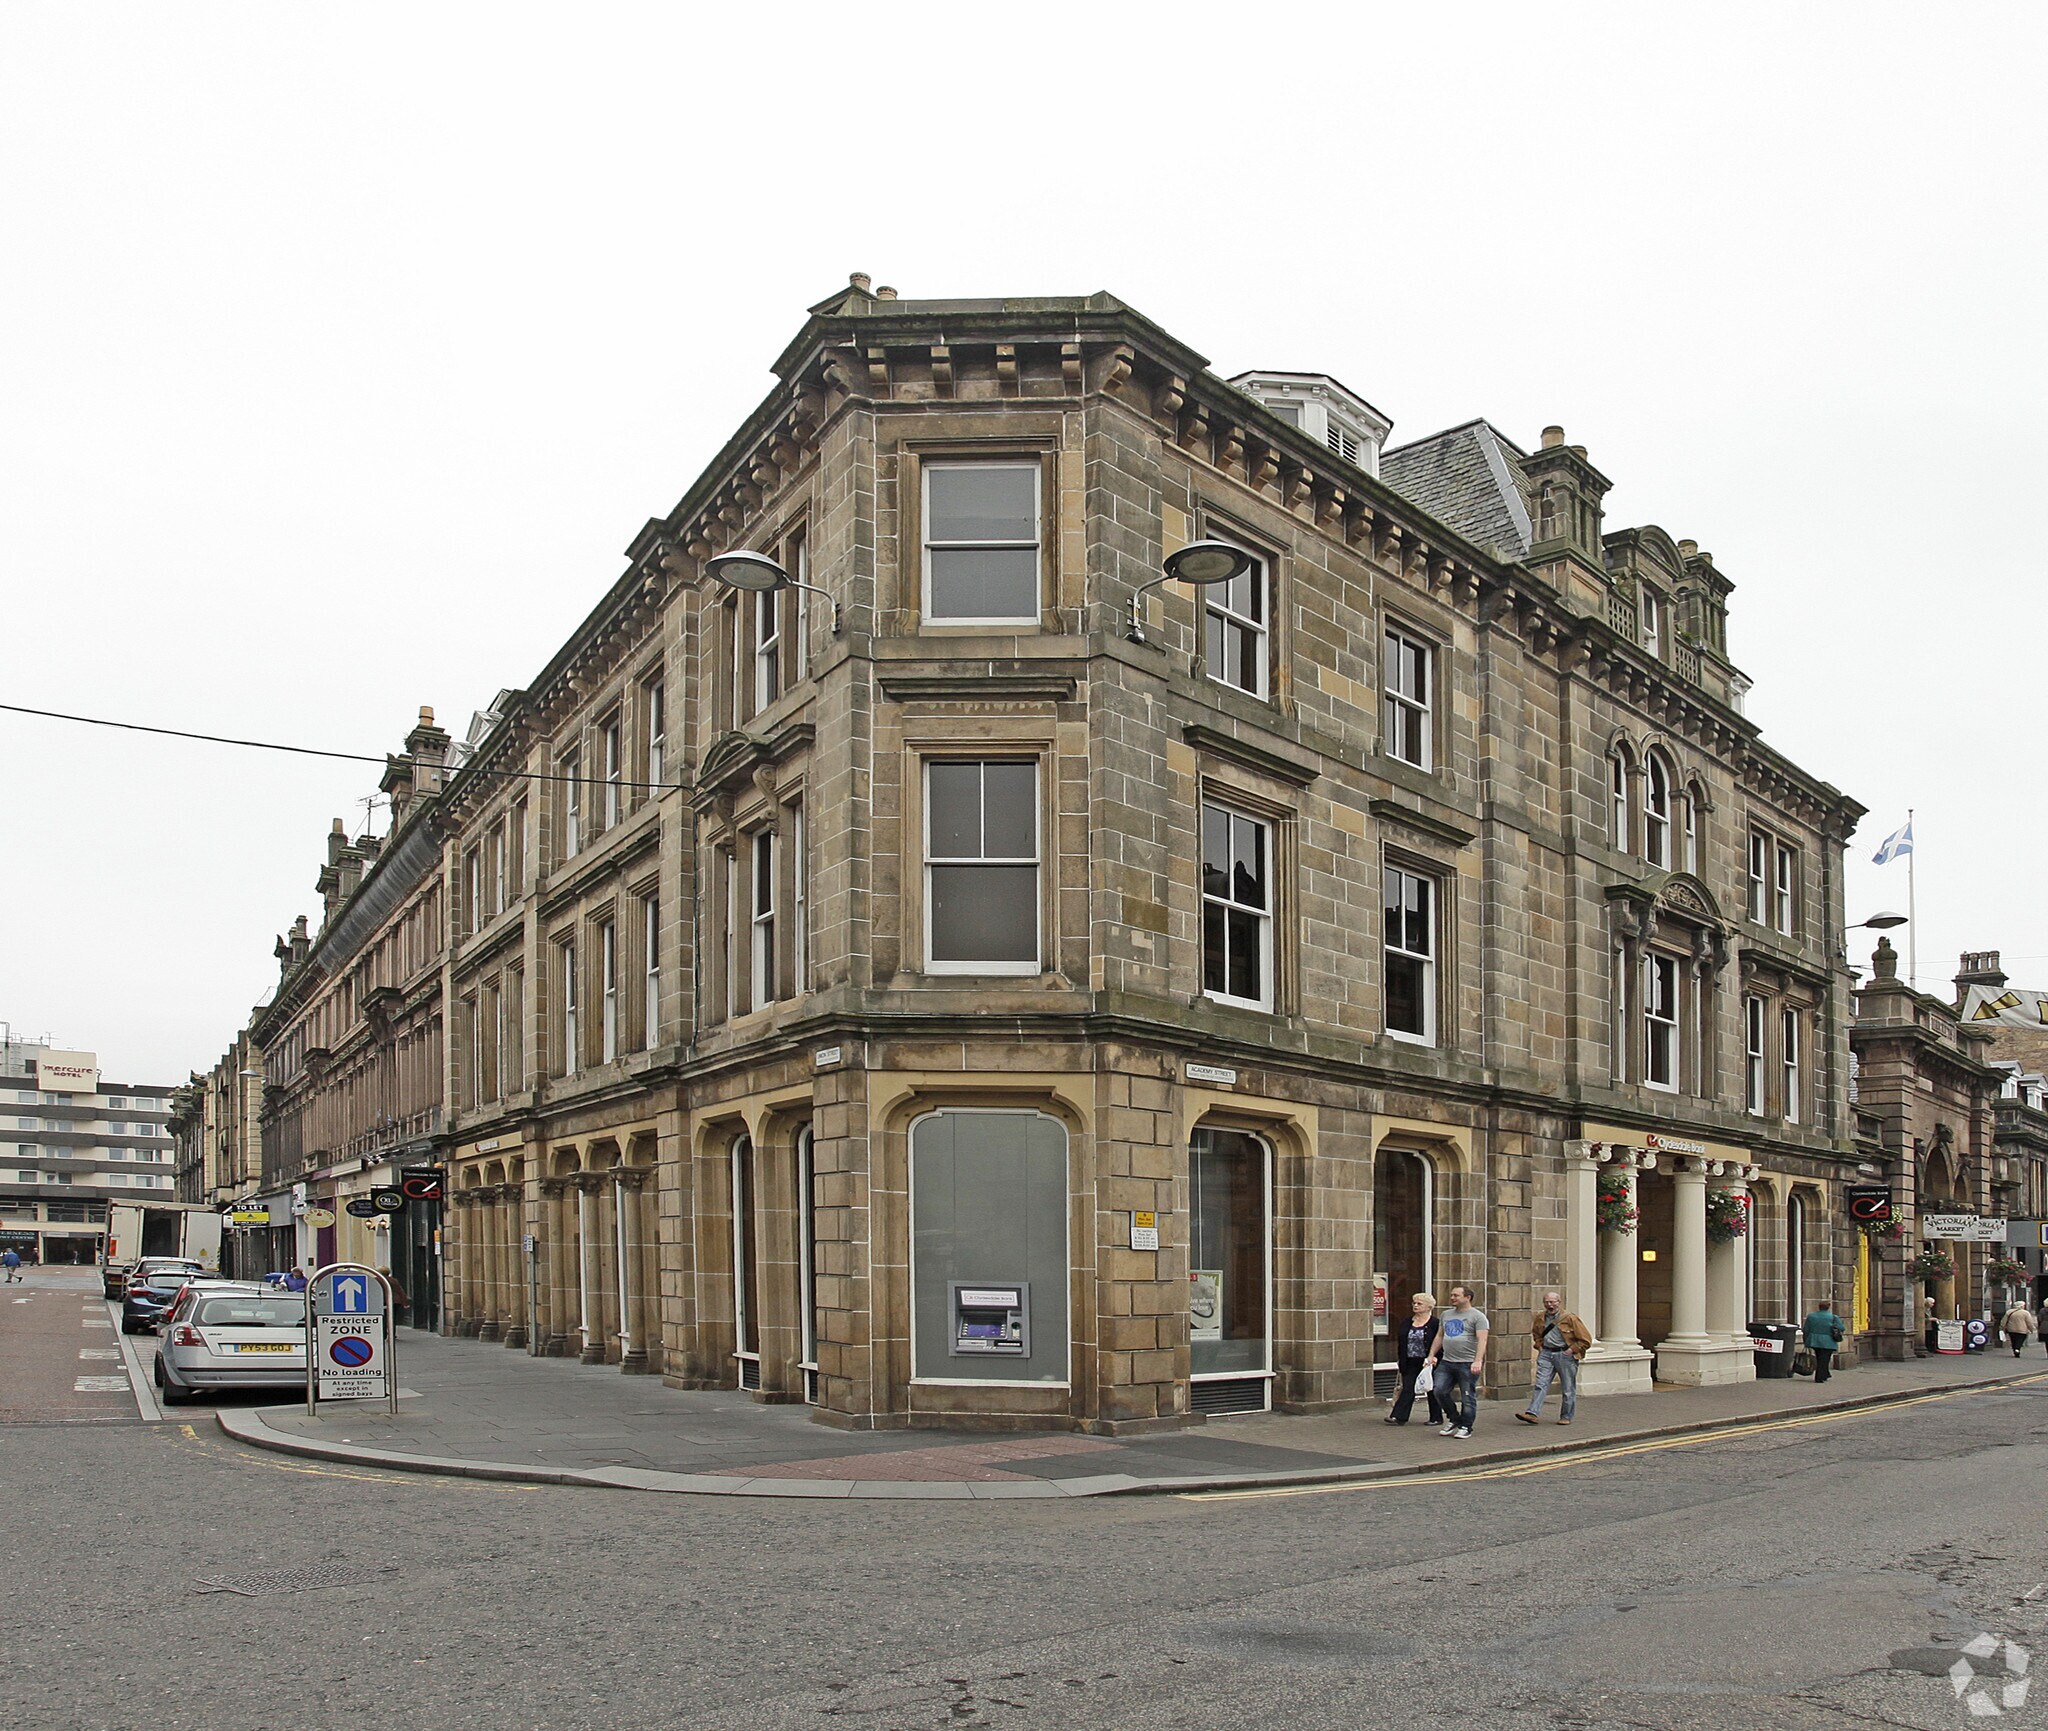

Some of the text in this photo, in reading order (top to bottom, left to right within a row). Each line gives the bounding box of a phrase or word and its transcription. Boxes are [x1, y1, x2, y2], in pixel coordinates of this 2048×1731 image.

[42, 1064, 93, 1074] mercure
[1191, 1066, 1214, 1074] ACADEMY
[1658, 1137, 1705, 1153] Clydesdale Bank
[1927, 1216, 1974, 1228] VICTORIAN
[330, 1326, 371, 1334] ZONE
[240, 1344, 268, 1352] PY53
